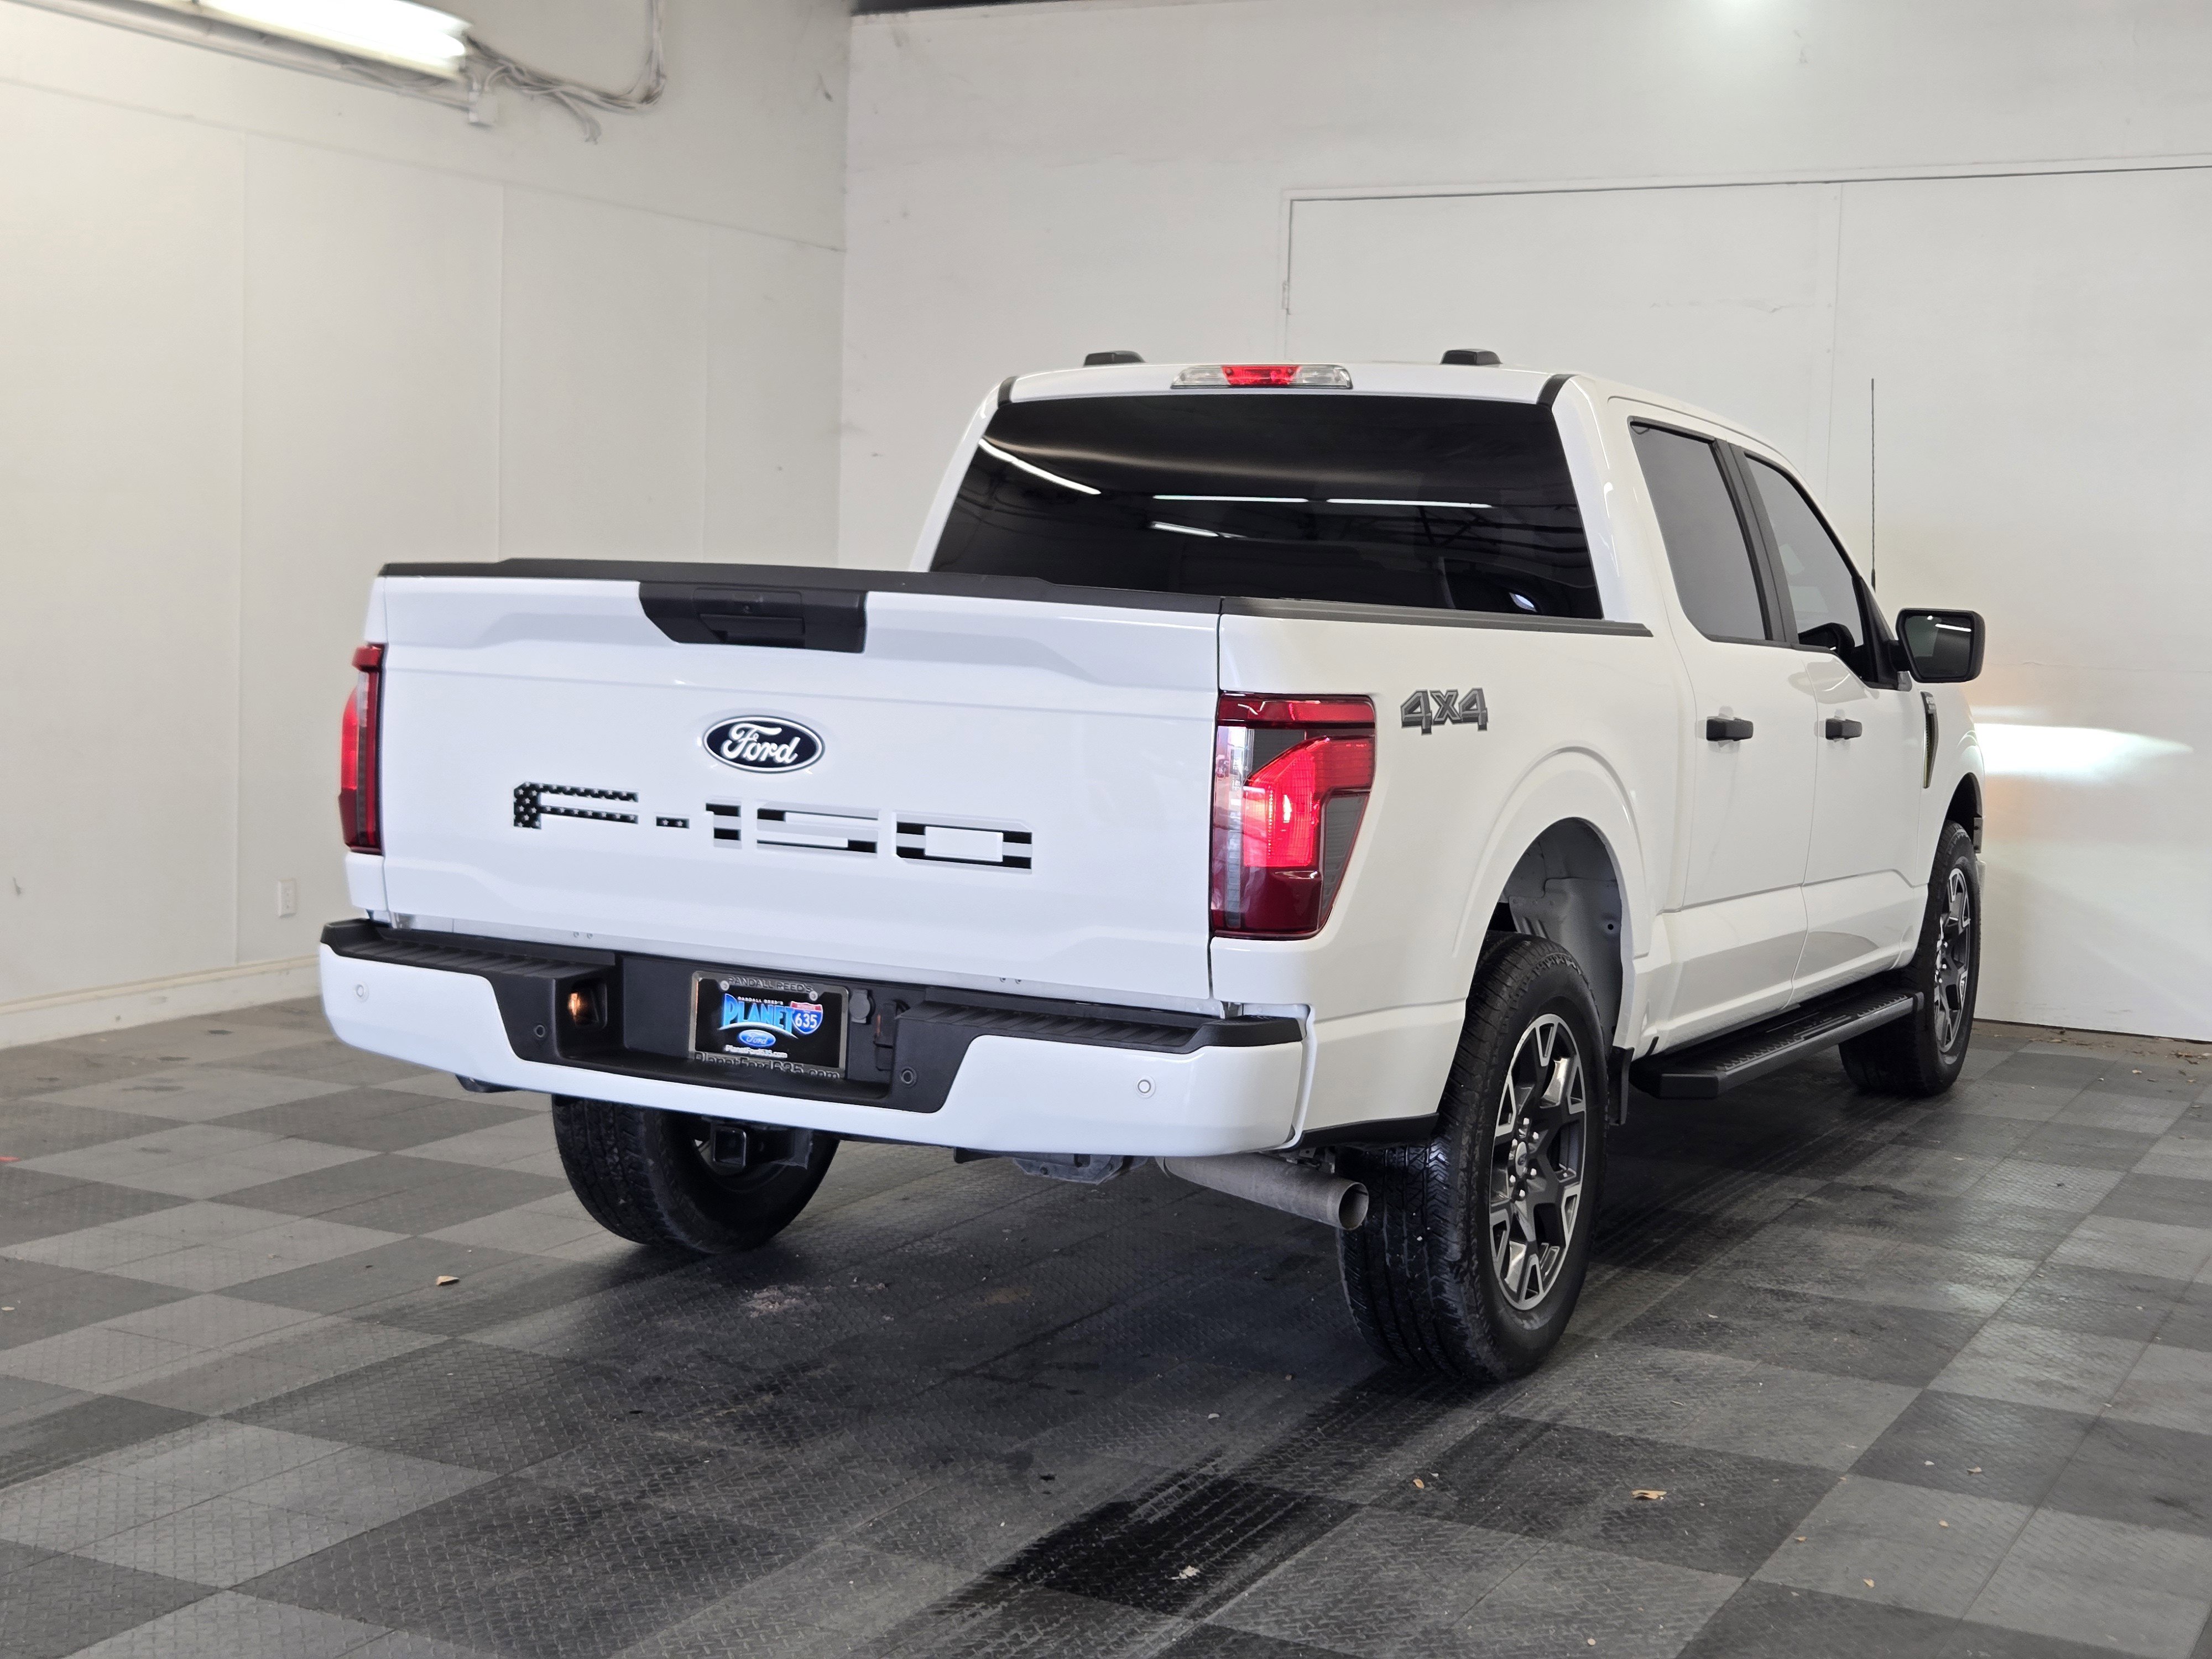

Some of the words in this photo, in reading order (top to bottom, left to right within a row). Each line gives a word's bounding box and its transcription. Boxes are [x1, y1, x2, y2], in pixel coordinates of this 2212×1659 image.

[721, 722, 801, 764] Ford
[513, 781, 1034, 875] F-150
[727, 975, 774, 990] RANDALL
[723, 993, 795, 1034] PLANET
[795, 1013, 818, 1029] 635
[745, 1031, 770, 1045] Ford
